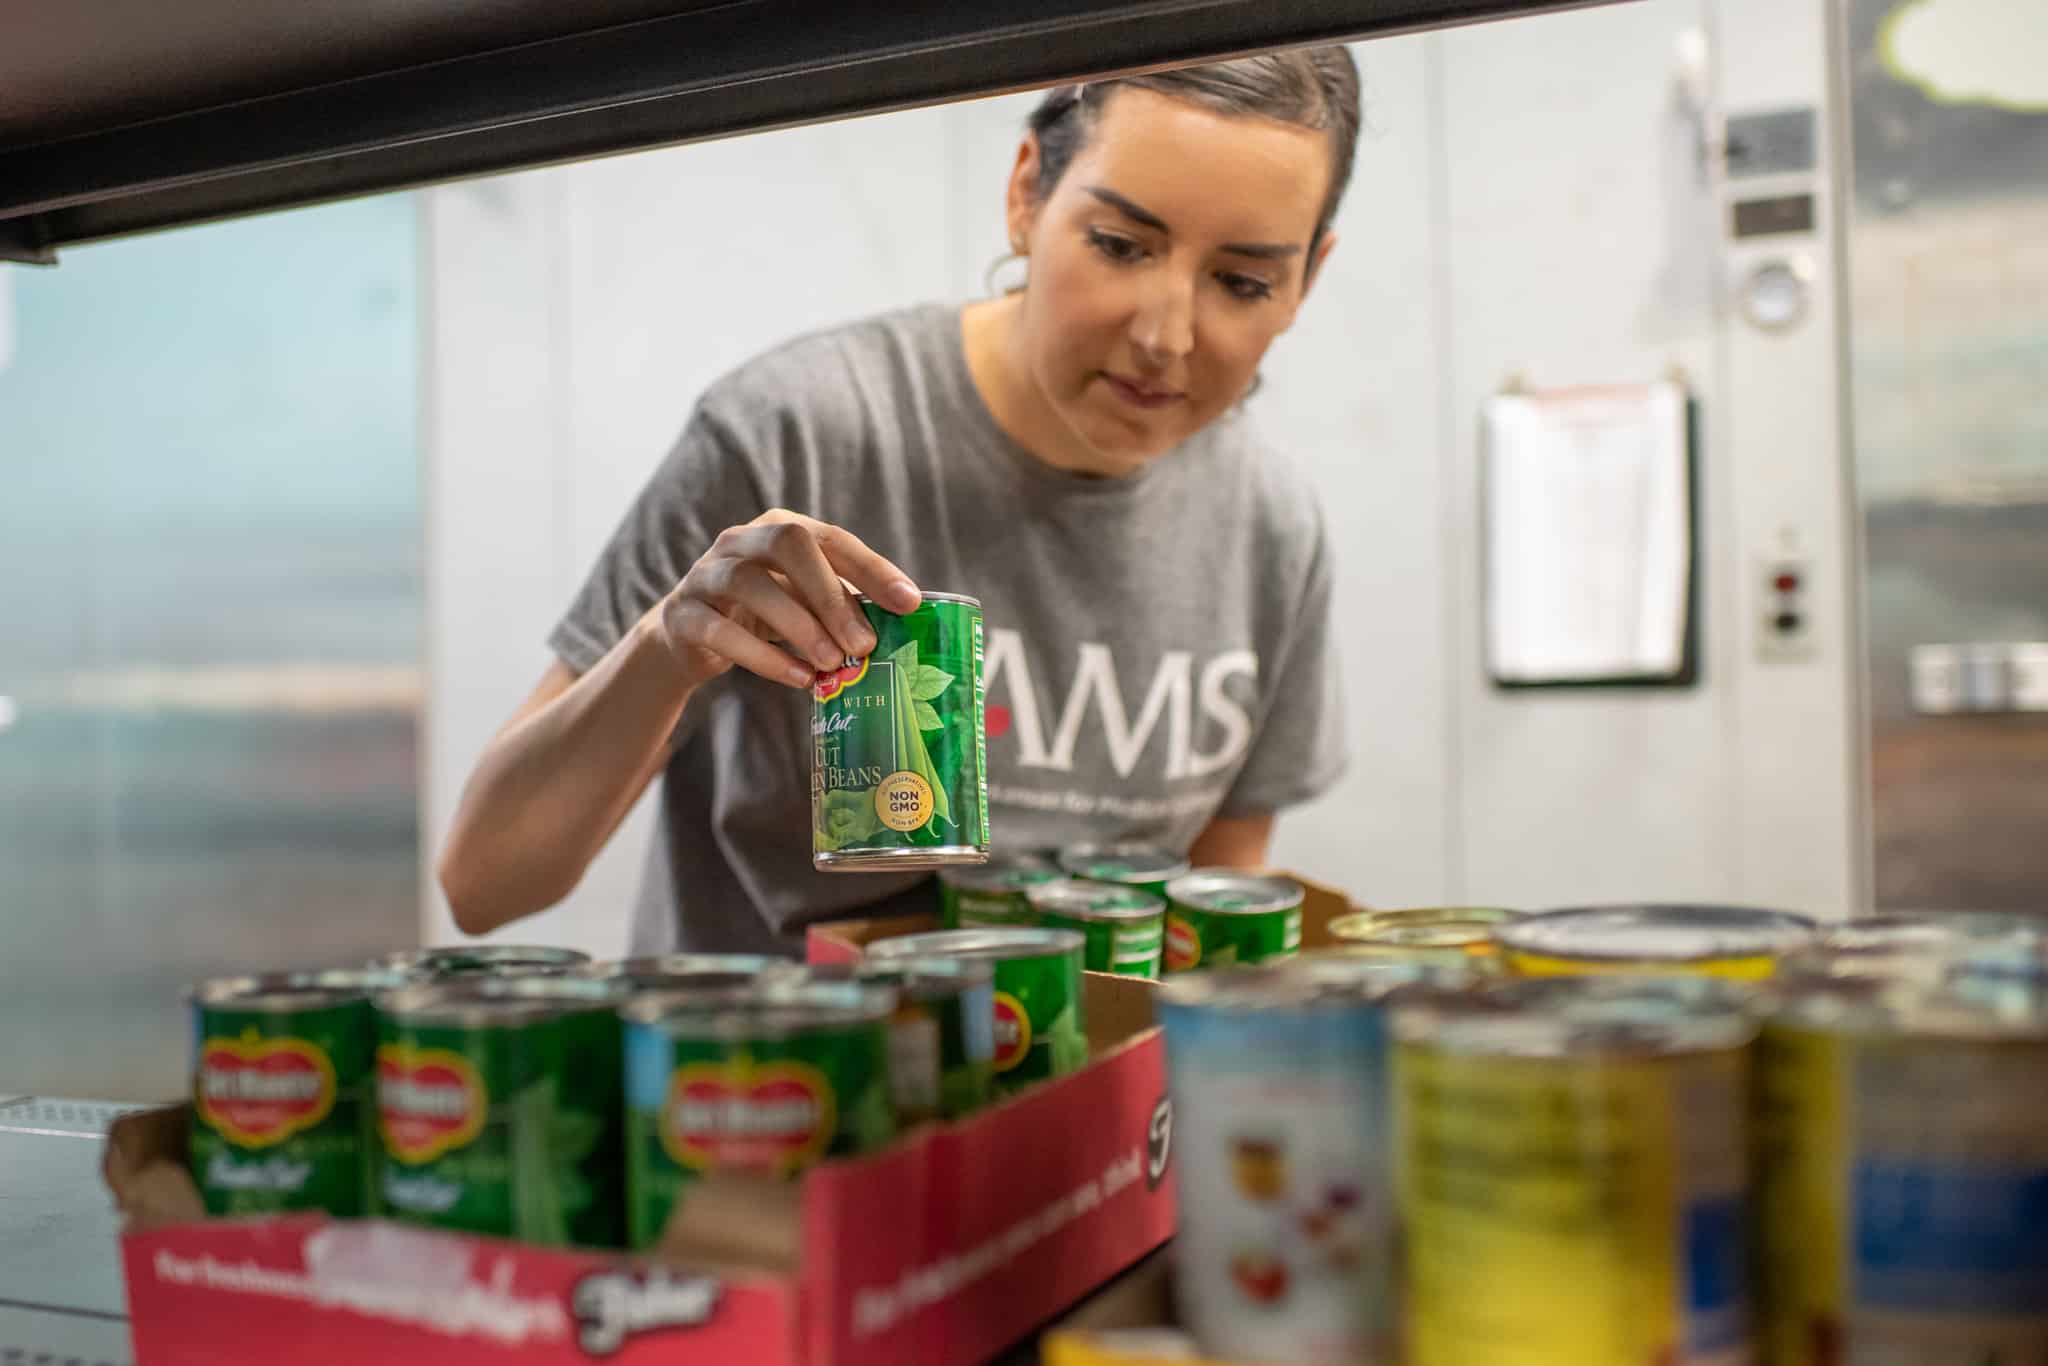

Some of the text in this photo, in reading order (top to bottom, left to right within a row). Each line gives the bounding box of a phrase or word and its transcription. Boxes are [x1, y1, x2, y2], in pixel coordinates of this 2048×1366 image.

[843, 695, 887, 709] WITH
[815, 746, 841, 767] CUT
[828, 765, 882, 789] BEANS
[890, 791, 919, 801] NON
[889, 802, 920, 812] GMO
